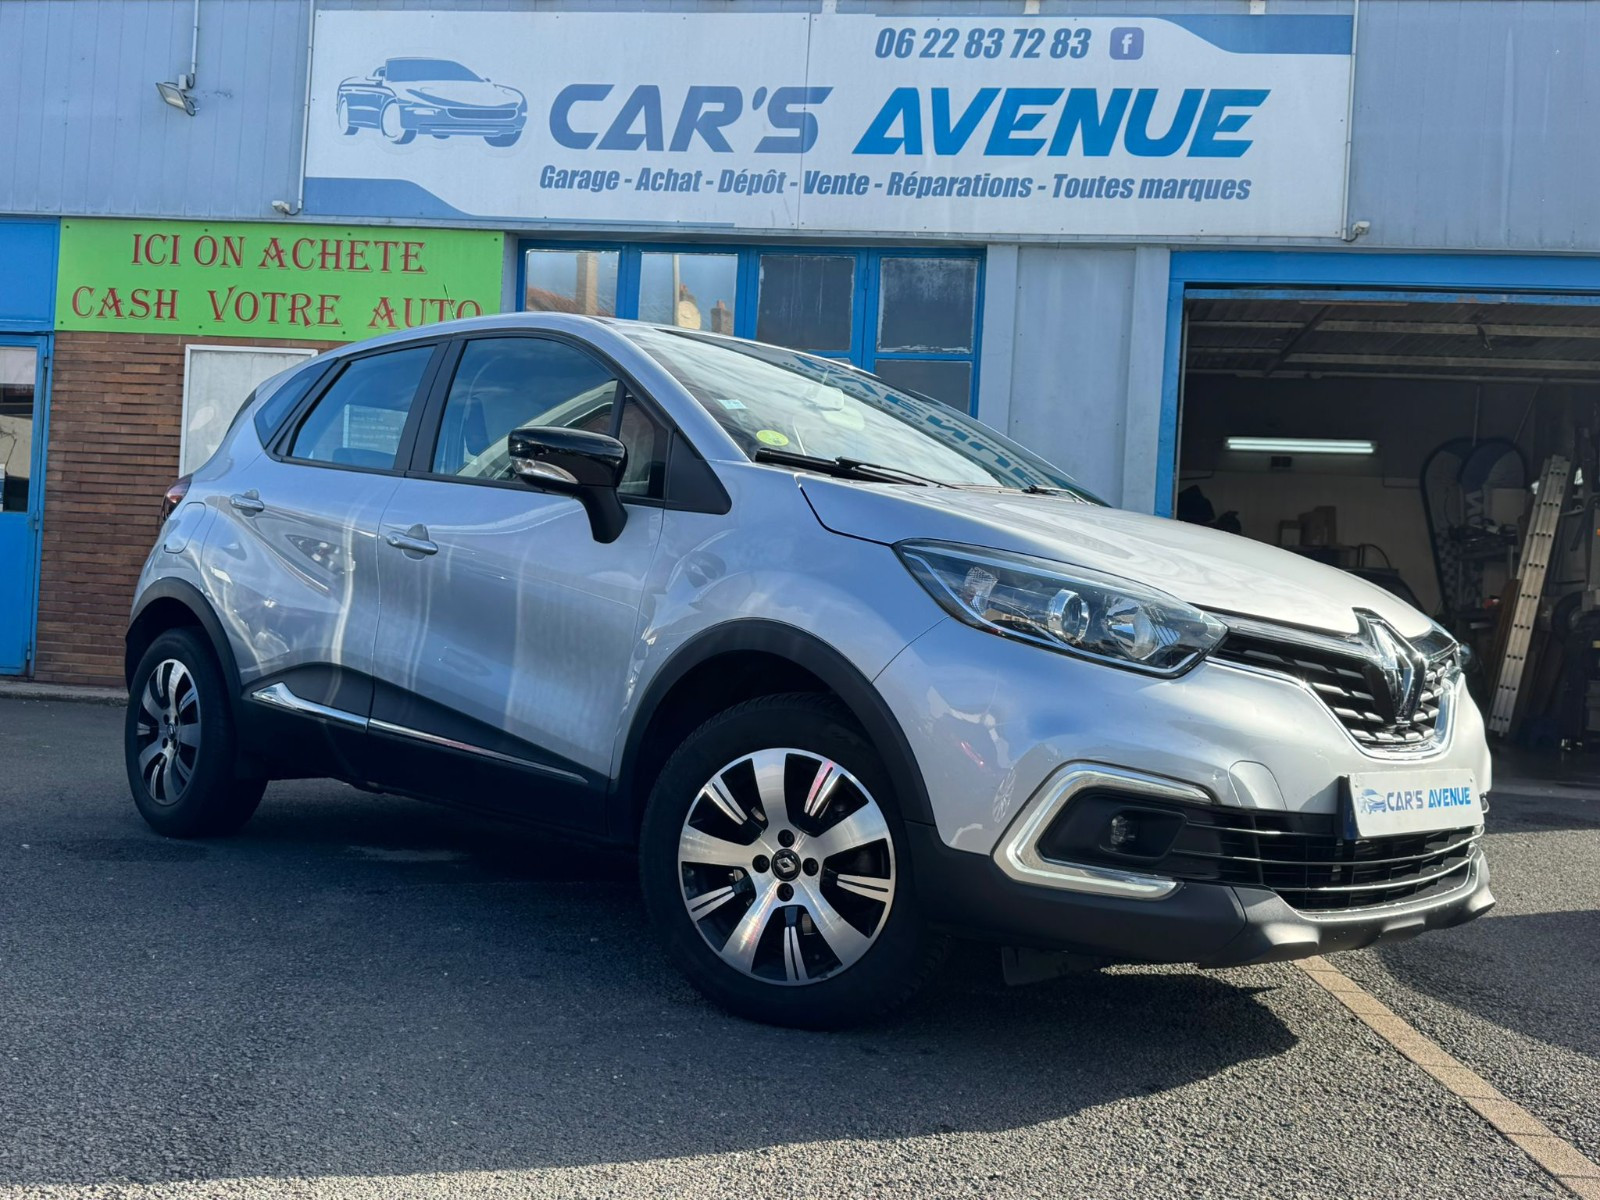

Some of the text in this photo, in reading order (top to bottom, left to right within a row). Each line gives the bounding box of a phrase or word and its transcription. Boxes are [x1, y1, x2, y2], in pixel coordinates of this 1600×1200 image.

[875, 28, 1092, 59] 06 22 83 72 83
[550, 84, 1271, 158] CAR'S AVENUE
[540, 165, 620, 193] Garage
[635, 167, 702, 193] Achat
[717, 168, 786, 196] Dépôt
[804, 170, 870, 196] Vente
[886, 171, 1034, 199] Réparations
[1053, 173, 1136, 200] Toutes
[1138, 177, 1252, 203] marques
[131, 233, 427, 274] ICI ON ACHETE
[71, 285, 484, 329] CASH VOTRE AUTO
[1386, 786, 1471, 812] CAR'S AVENUE
